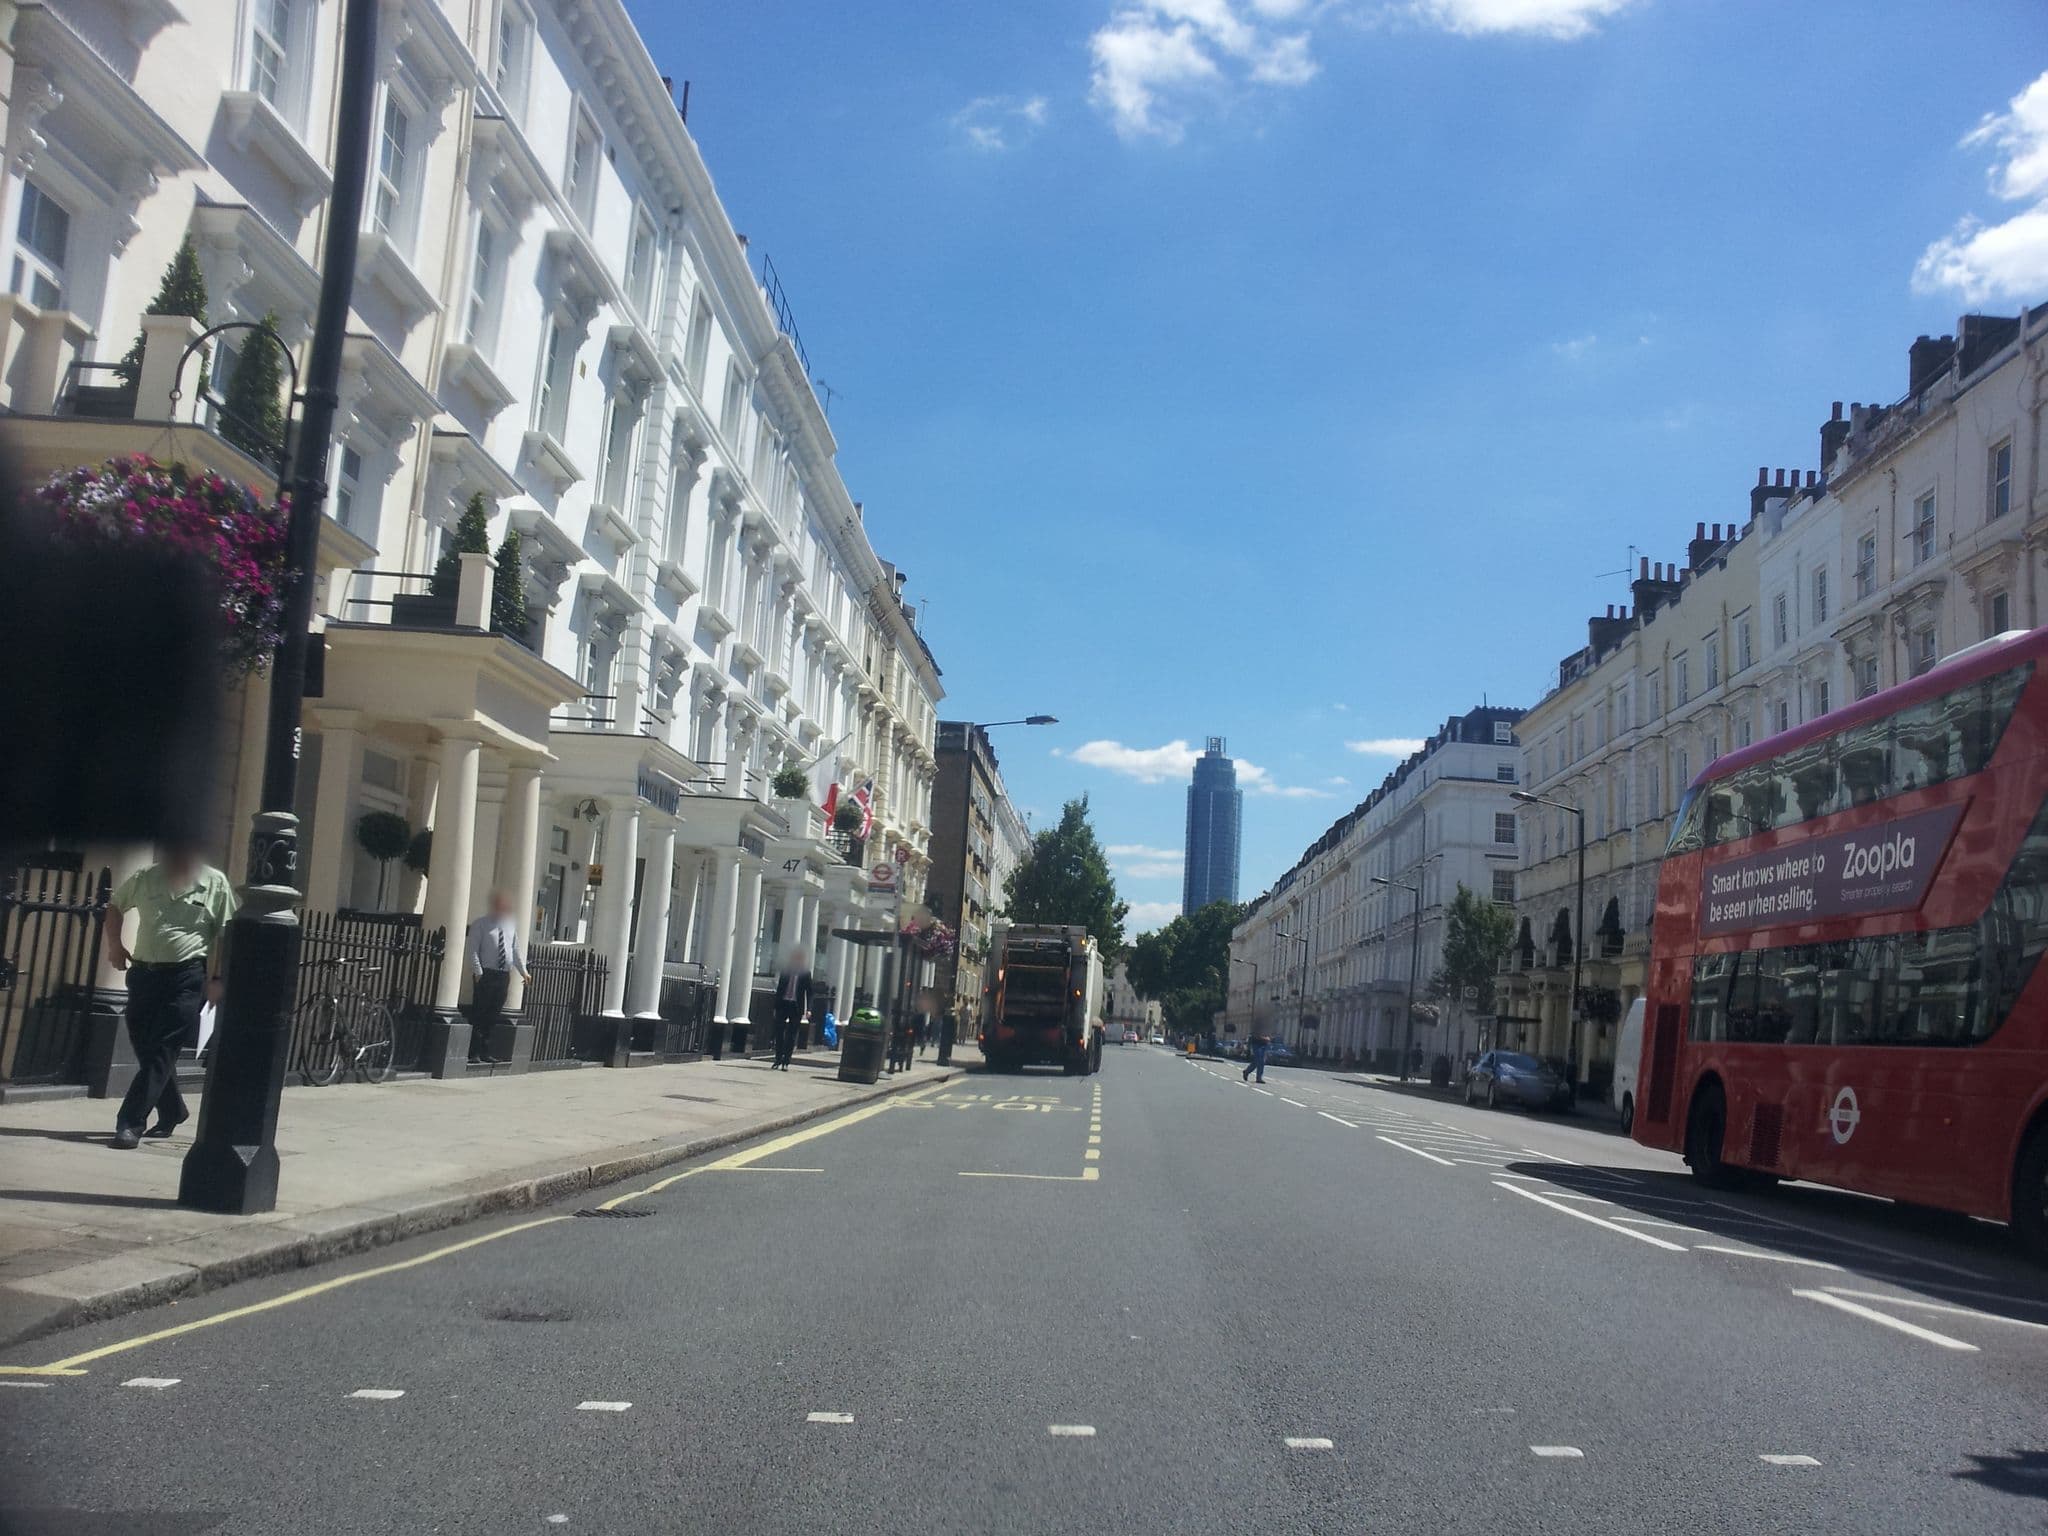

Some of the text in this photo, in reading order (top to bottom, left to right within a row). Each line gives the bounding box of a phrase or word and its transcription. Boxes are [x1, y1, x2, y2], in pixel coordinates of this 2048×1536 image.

[782, 859, 801, 873] 47
[1711, 853, 1826, 895] Smart knows where to
[1842, 831, 1916, 881] Zoopla
[1709, 885, 1817, 922] be seen when selling.
